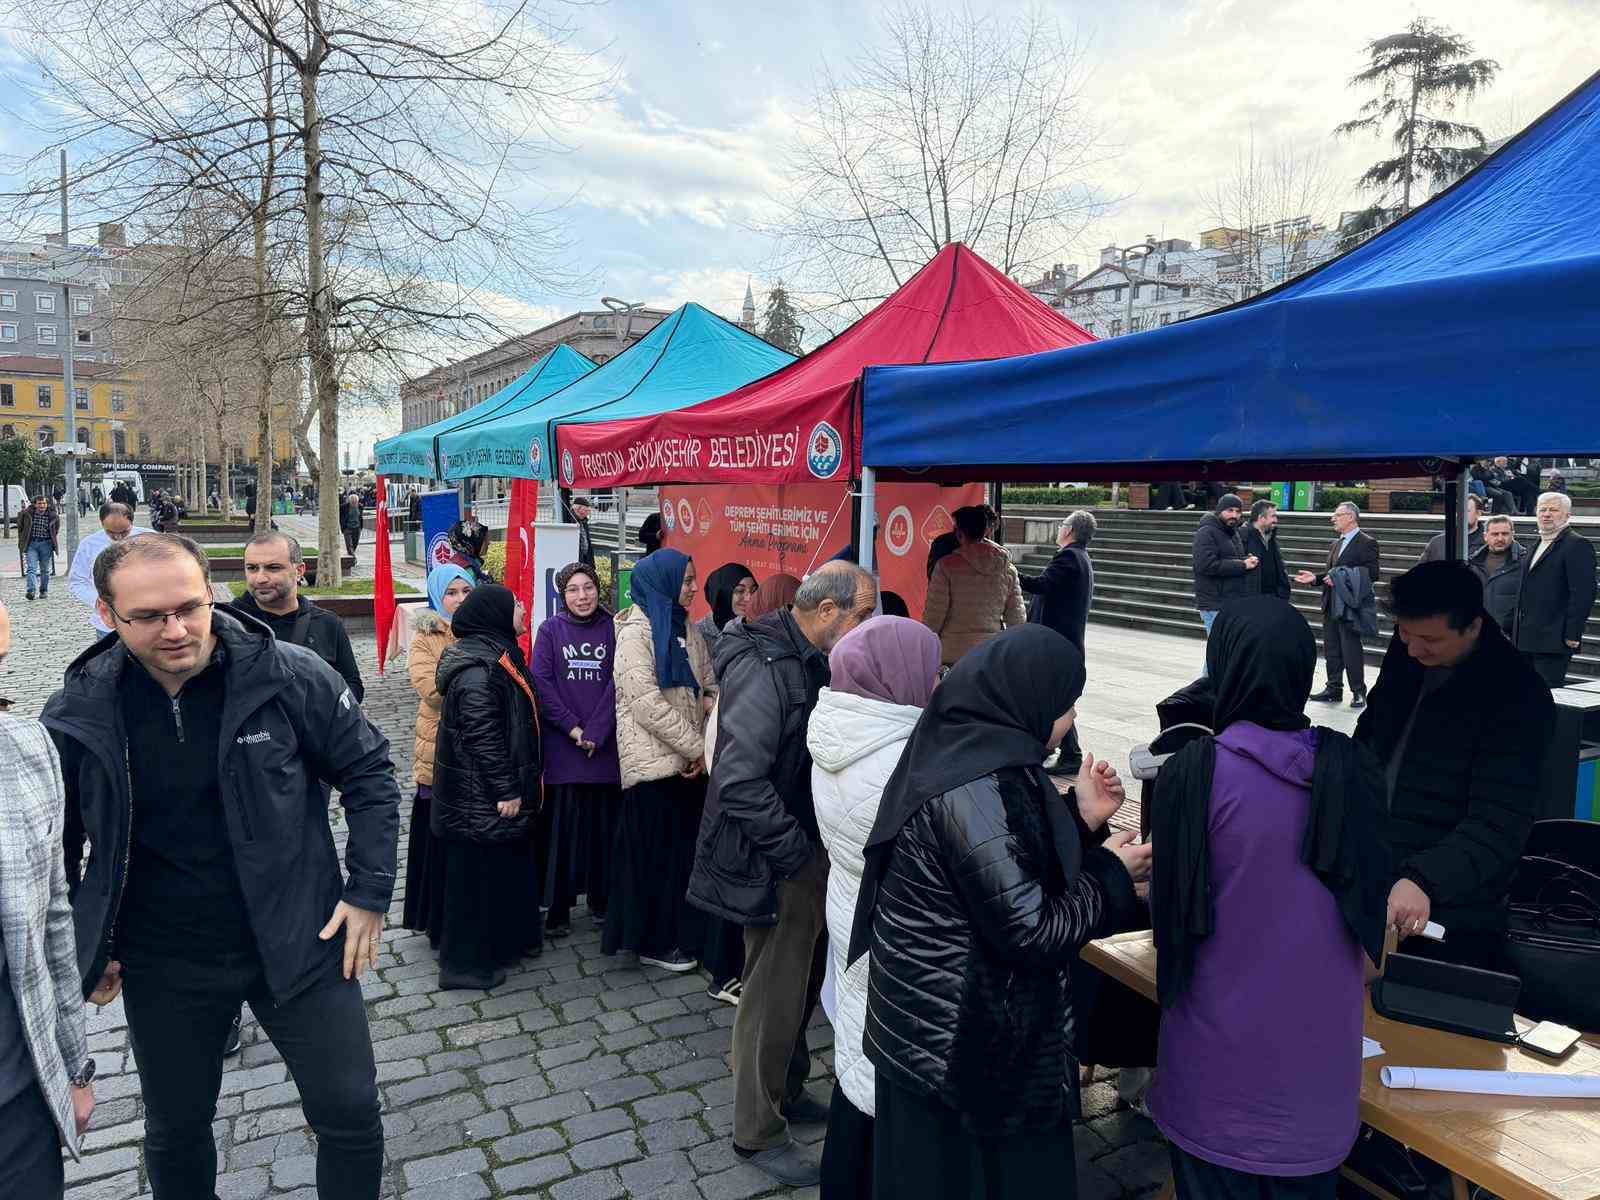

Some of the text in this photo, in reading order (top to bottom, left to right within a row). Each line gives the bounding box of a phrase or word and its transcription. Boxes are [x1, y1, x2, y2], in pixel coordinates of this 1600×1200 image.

[580, 450, 625, 480] TRABZON
[627, 433, 702, 475] BÜYÜKŞEHİR
[708, 425, 800, 468] BELEDİYESİ
[142, 463, 176, 471] COMPANY
[724, 505, 756, 519] DEPREM
[814, 510, 829, 525] VE
[562, 641, 608, 660] MCÖ
